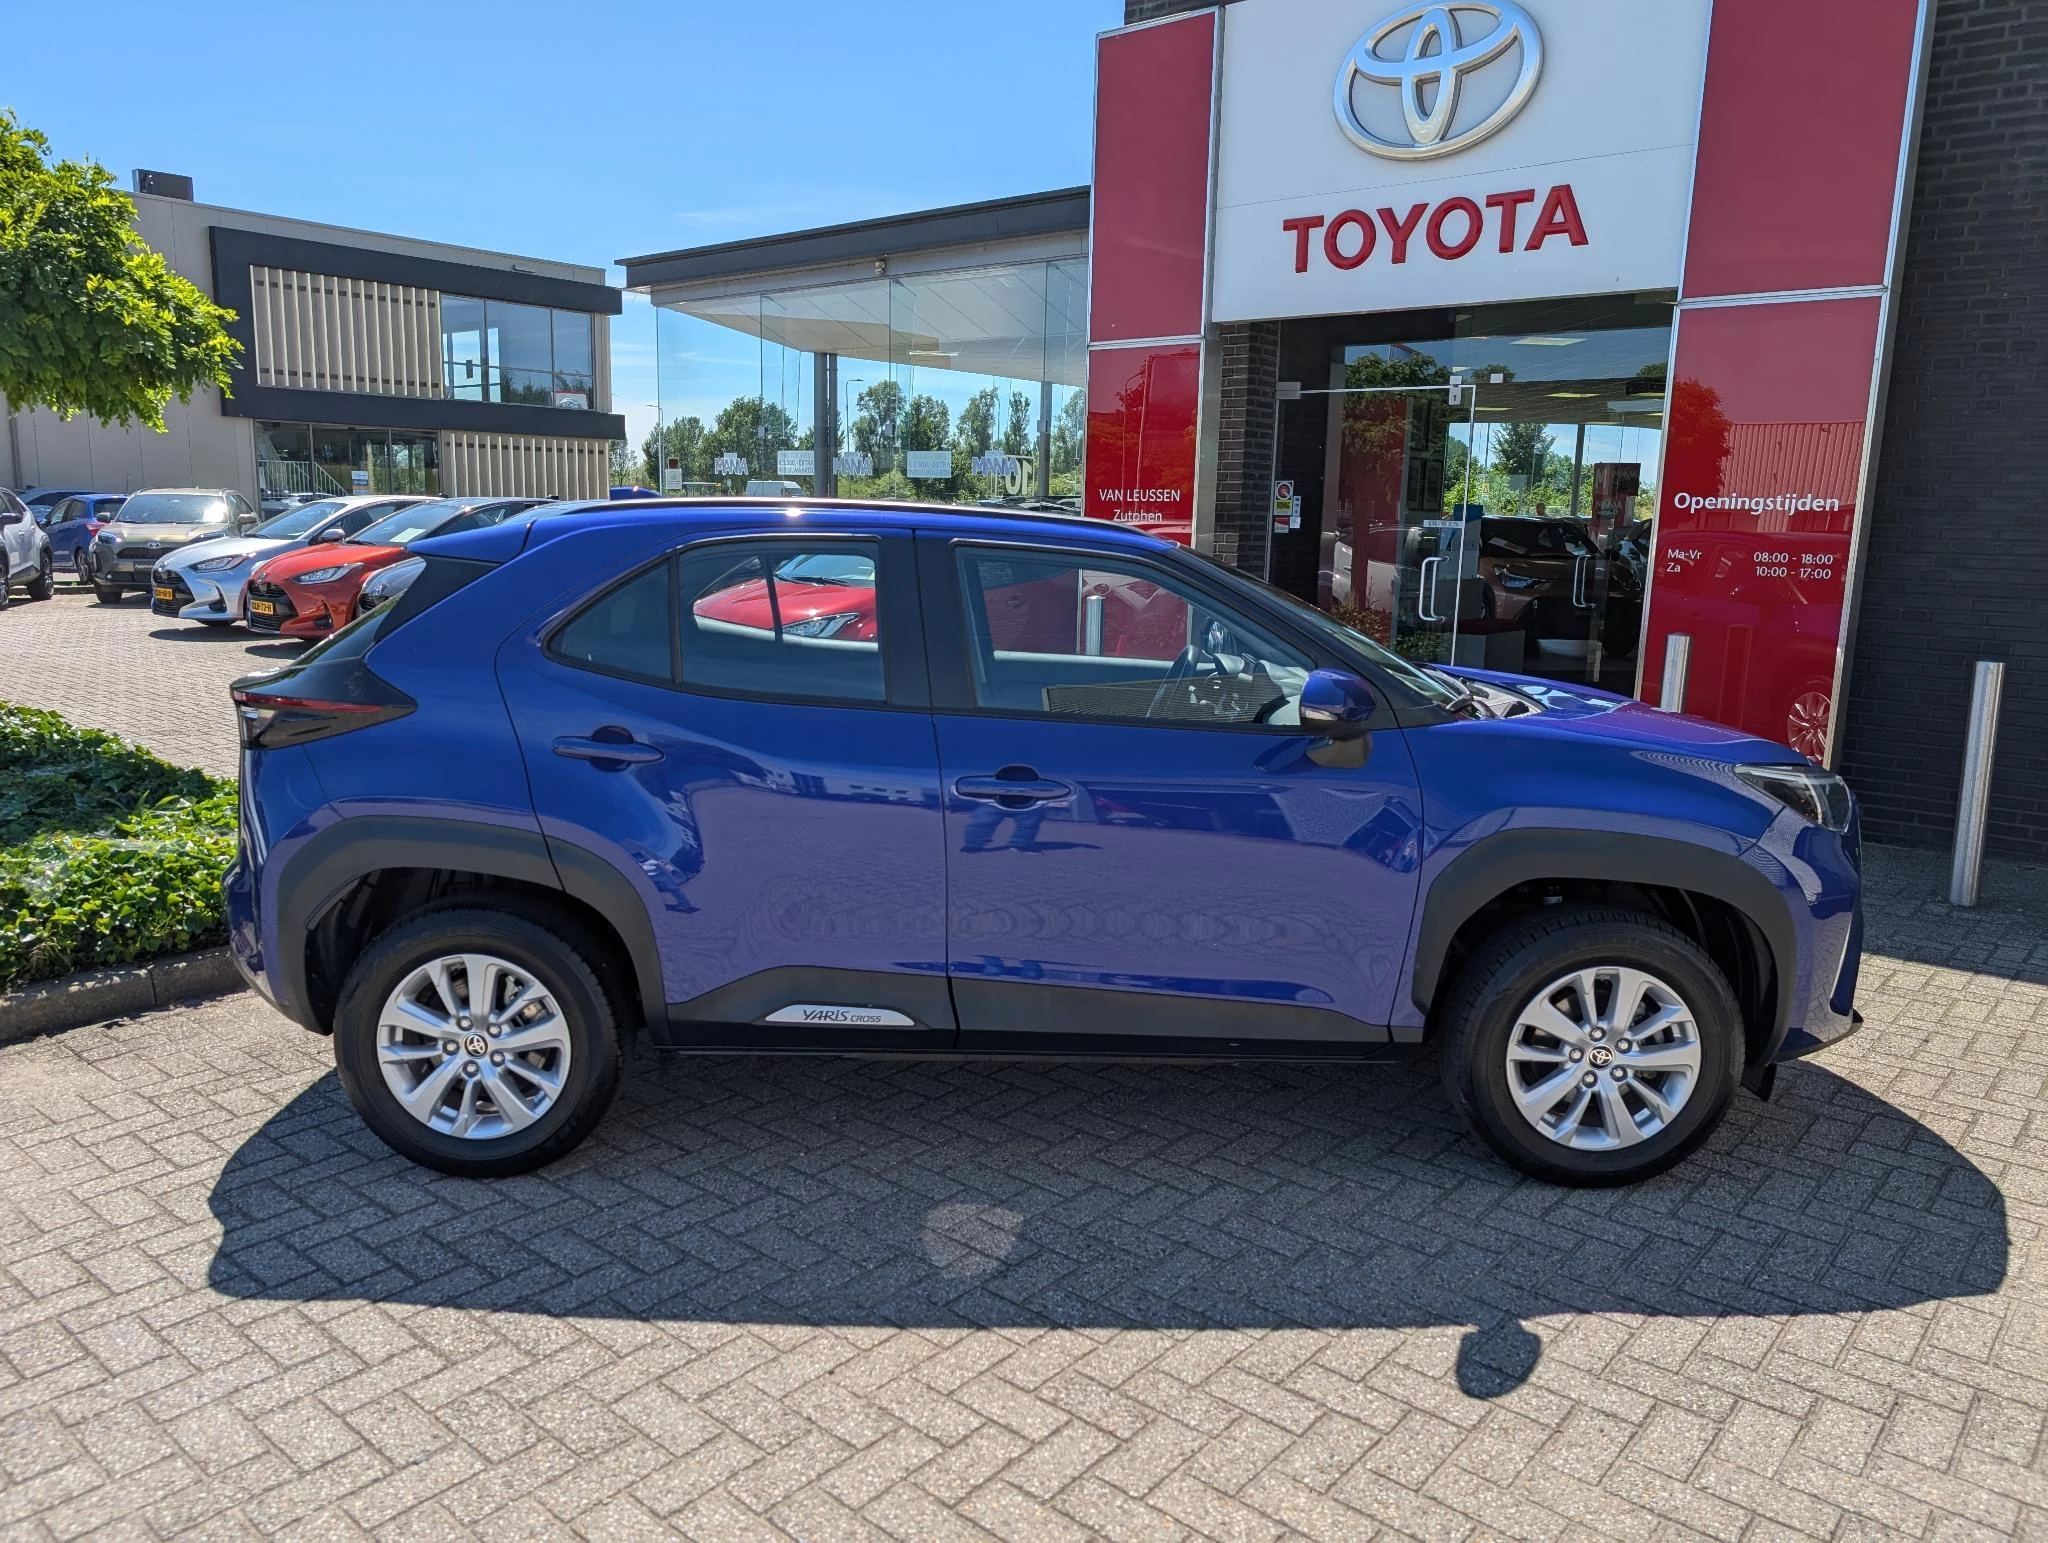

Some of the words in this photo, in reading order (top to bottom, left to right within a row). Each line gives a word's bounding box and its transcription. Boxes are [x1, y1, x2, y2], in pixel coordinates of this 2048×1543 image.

[1282, 183, 1589, 273] TOYOTA
[714, 457, 749, 476] MANIA
[832, 457, 874, 476] MANIA
[971, 456, 1019, 477] MANIA
[1099, 488, 1123, 501] VAN
[1126, 488, 1180, 502] LEUSSEN
[1674, 492, 1840, 516] Openingstijden
[1113, 508, 1162, 523] Zutphen
[1667, 548, 1702, 560] Ma-Vr
[1753, 551, 1789, 563] 08:00
[1801, 554, 1834, 565] 18:00
[1666, 562, 1681, 573] Za
[1755, 566, 1787, 578] 10:00
[1799, 568, 1832, 579] 17:00
[850, 1014, 882, 1023] CROSS
